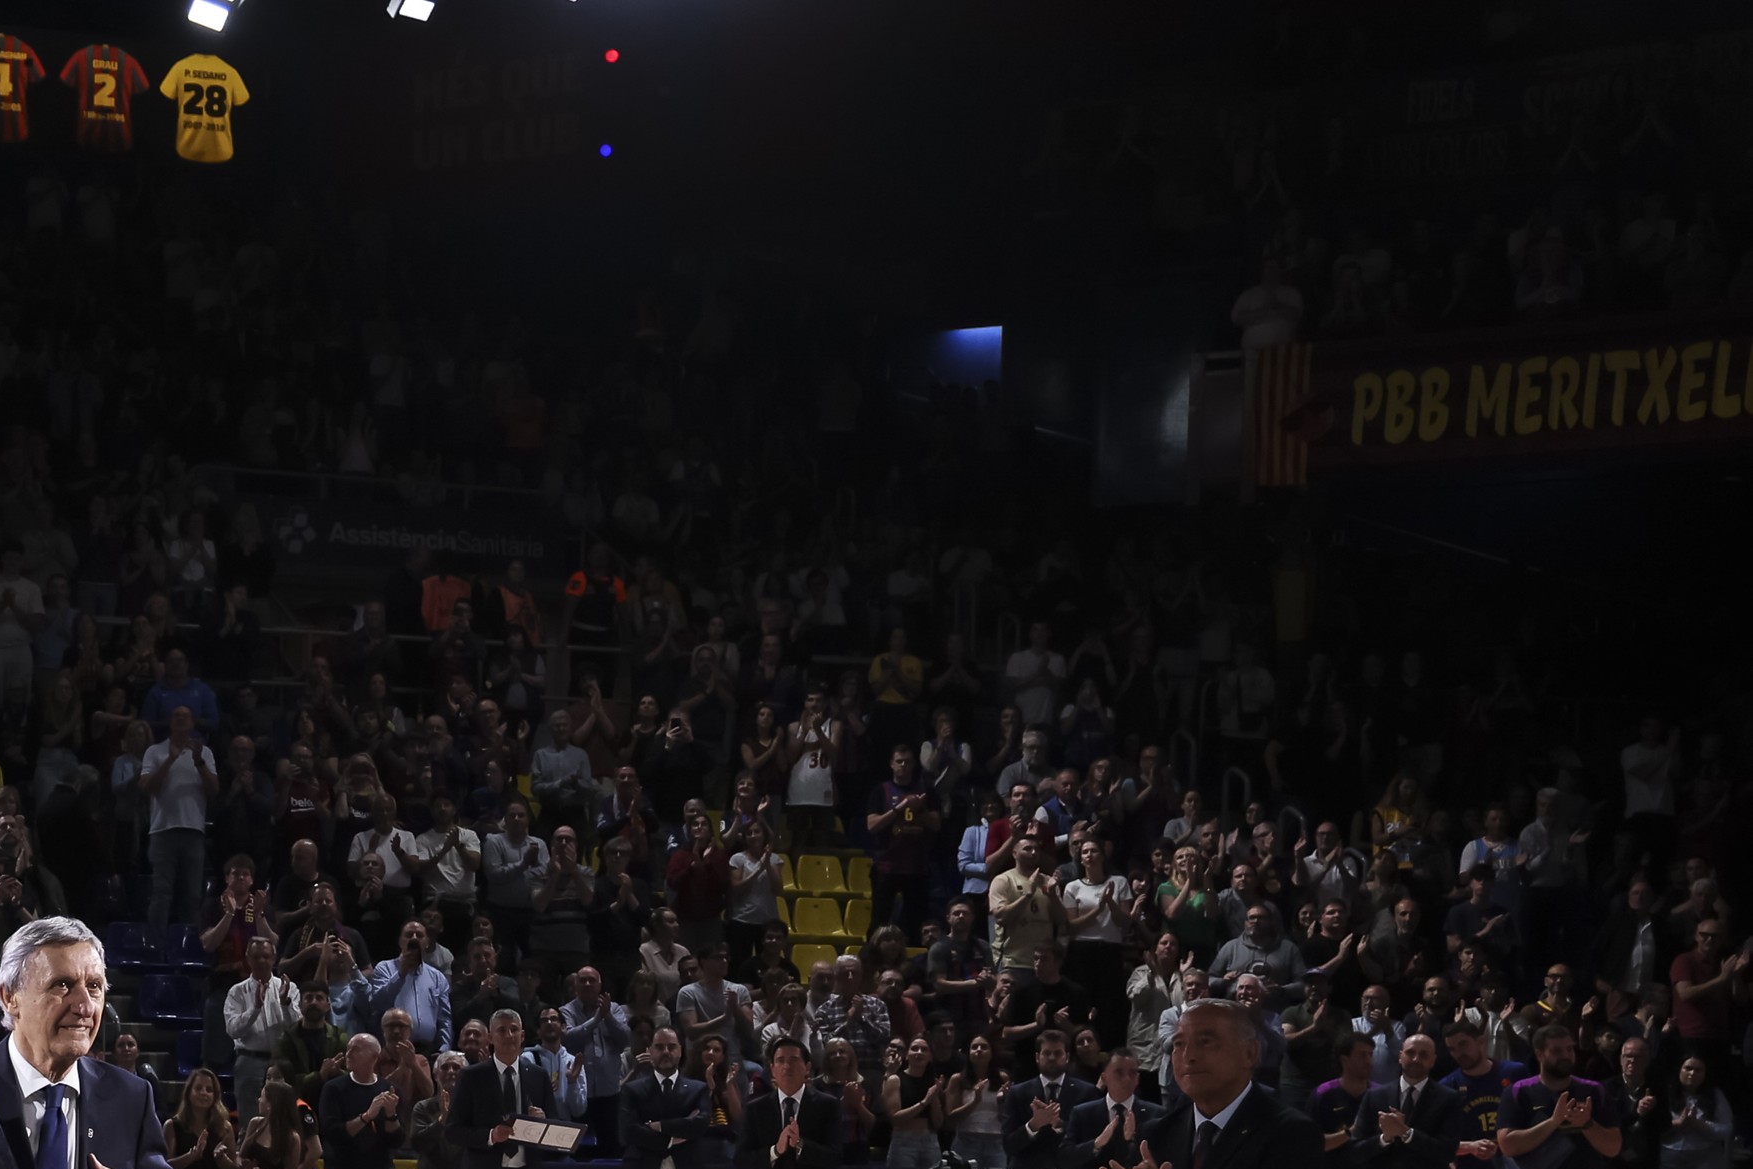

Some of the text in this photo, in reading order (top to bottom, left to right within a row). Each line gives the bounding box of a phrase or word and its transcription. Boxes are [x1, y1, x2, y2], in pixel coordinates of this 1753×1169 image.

[93, 73, 116, 108] 2
[183, 83, 228, 118] 28
[1351, 366, 1451, 446] PBB
